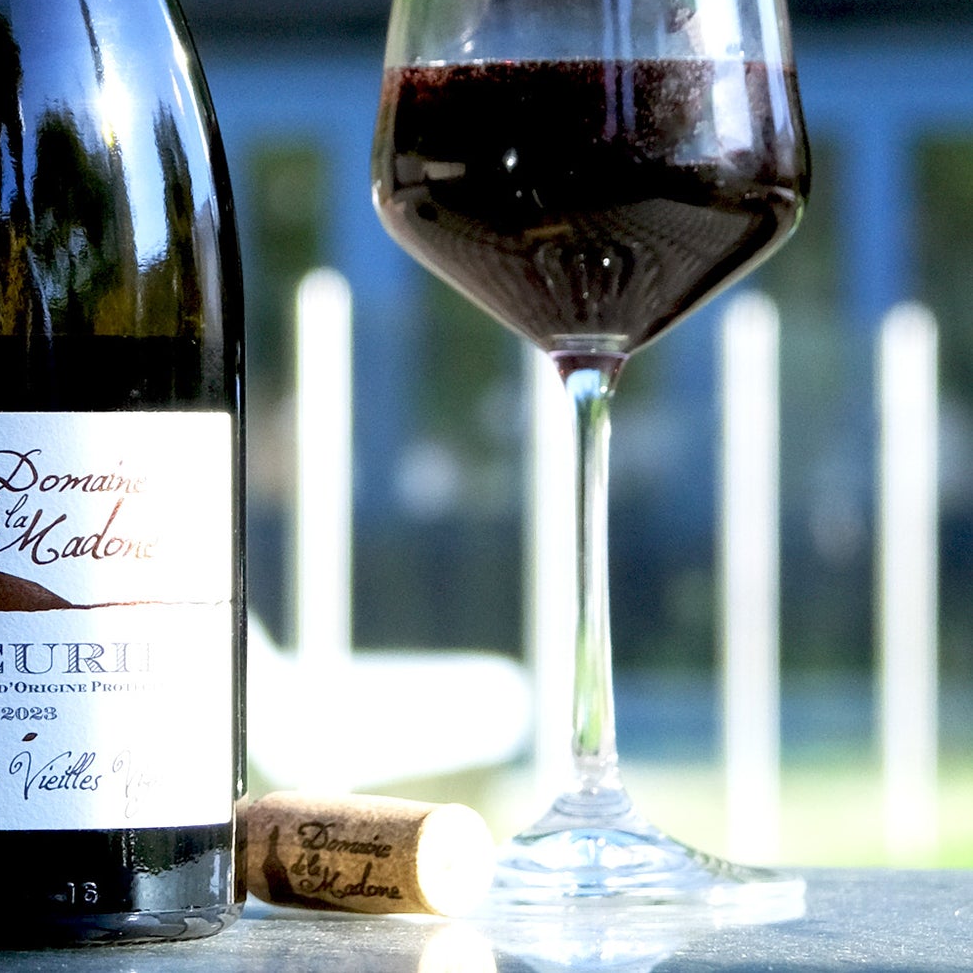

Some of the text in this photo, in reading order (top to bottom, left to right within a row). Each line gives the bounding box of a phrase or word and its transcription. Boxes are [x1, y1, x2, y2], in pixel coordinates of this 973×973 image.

[4, 493, 29, 529] la
[0, 705, 59, 722] 2023
[8, 750, 103, 801] Vieilles
[298, 822, 392, 858] Domaine
[290, 854, 306, 876] de
[300, 862, 403, 899] Madone
